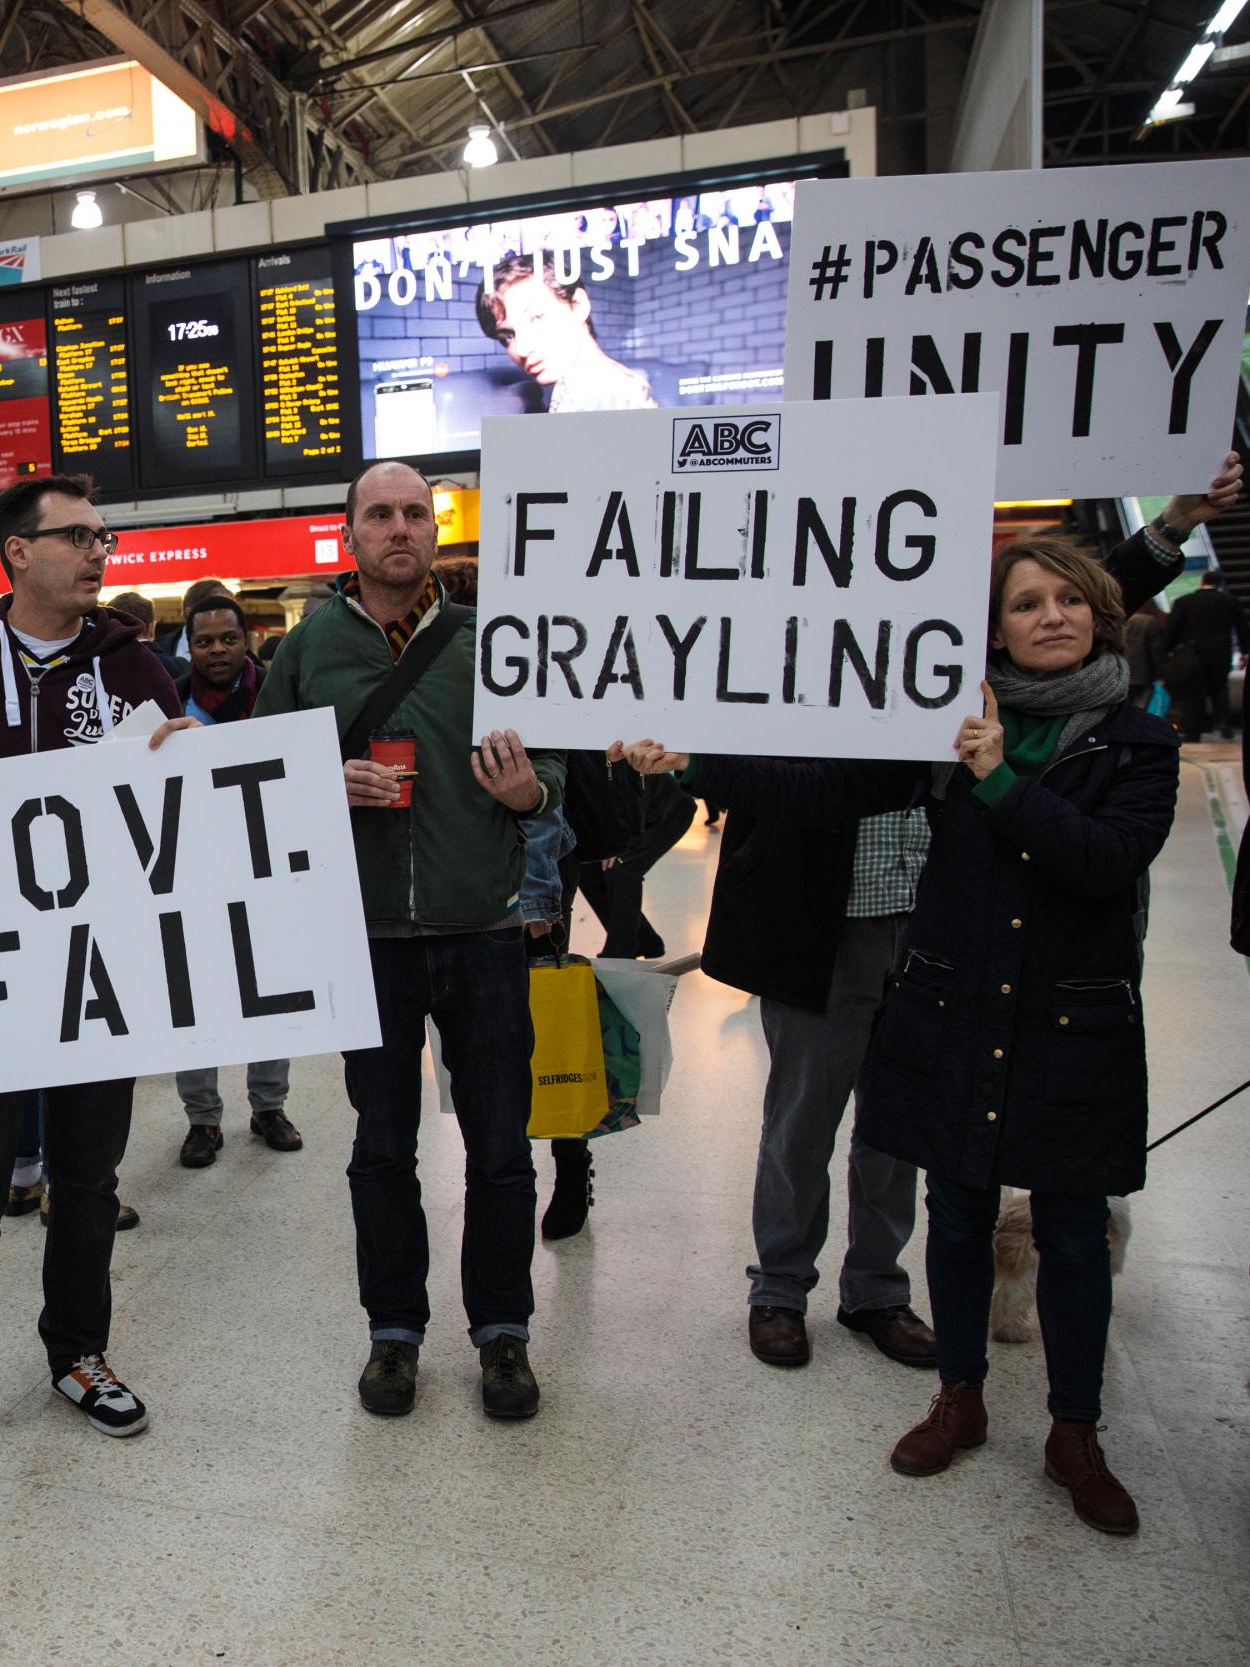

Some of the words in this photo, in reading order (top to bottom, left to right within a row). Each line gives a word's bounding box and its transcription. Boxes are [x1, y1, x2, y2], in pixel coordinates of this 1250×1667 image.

[258, 255, 290, 268] Arrivals
[674, 220, 783, 271] SNA
[809, 211, 1228, 301] #PASSENGER
[53, 288, 71, 297] Next
[72, 284, 98, 295] fastest
[146, 271, 191, 284] Information
[813, 319, 1224, 446] UNITY
[679, 421, 772, 457] ABC
[690, 456, 772, 467] @ABCOMMUTERS
[513, 489, 938, 587] FAILING
[105, 552, 144, 567] TWICK
[149, 547, 208, 562] EXPRESS
[480, 614, 964, 711] GRAYLING
